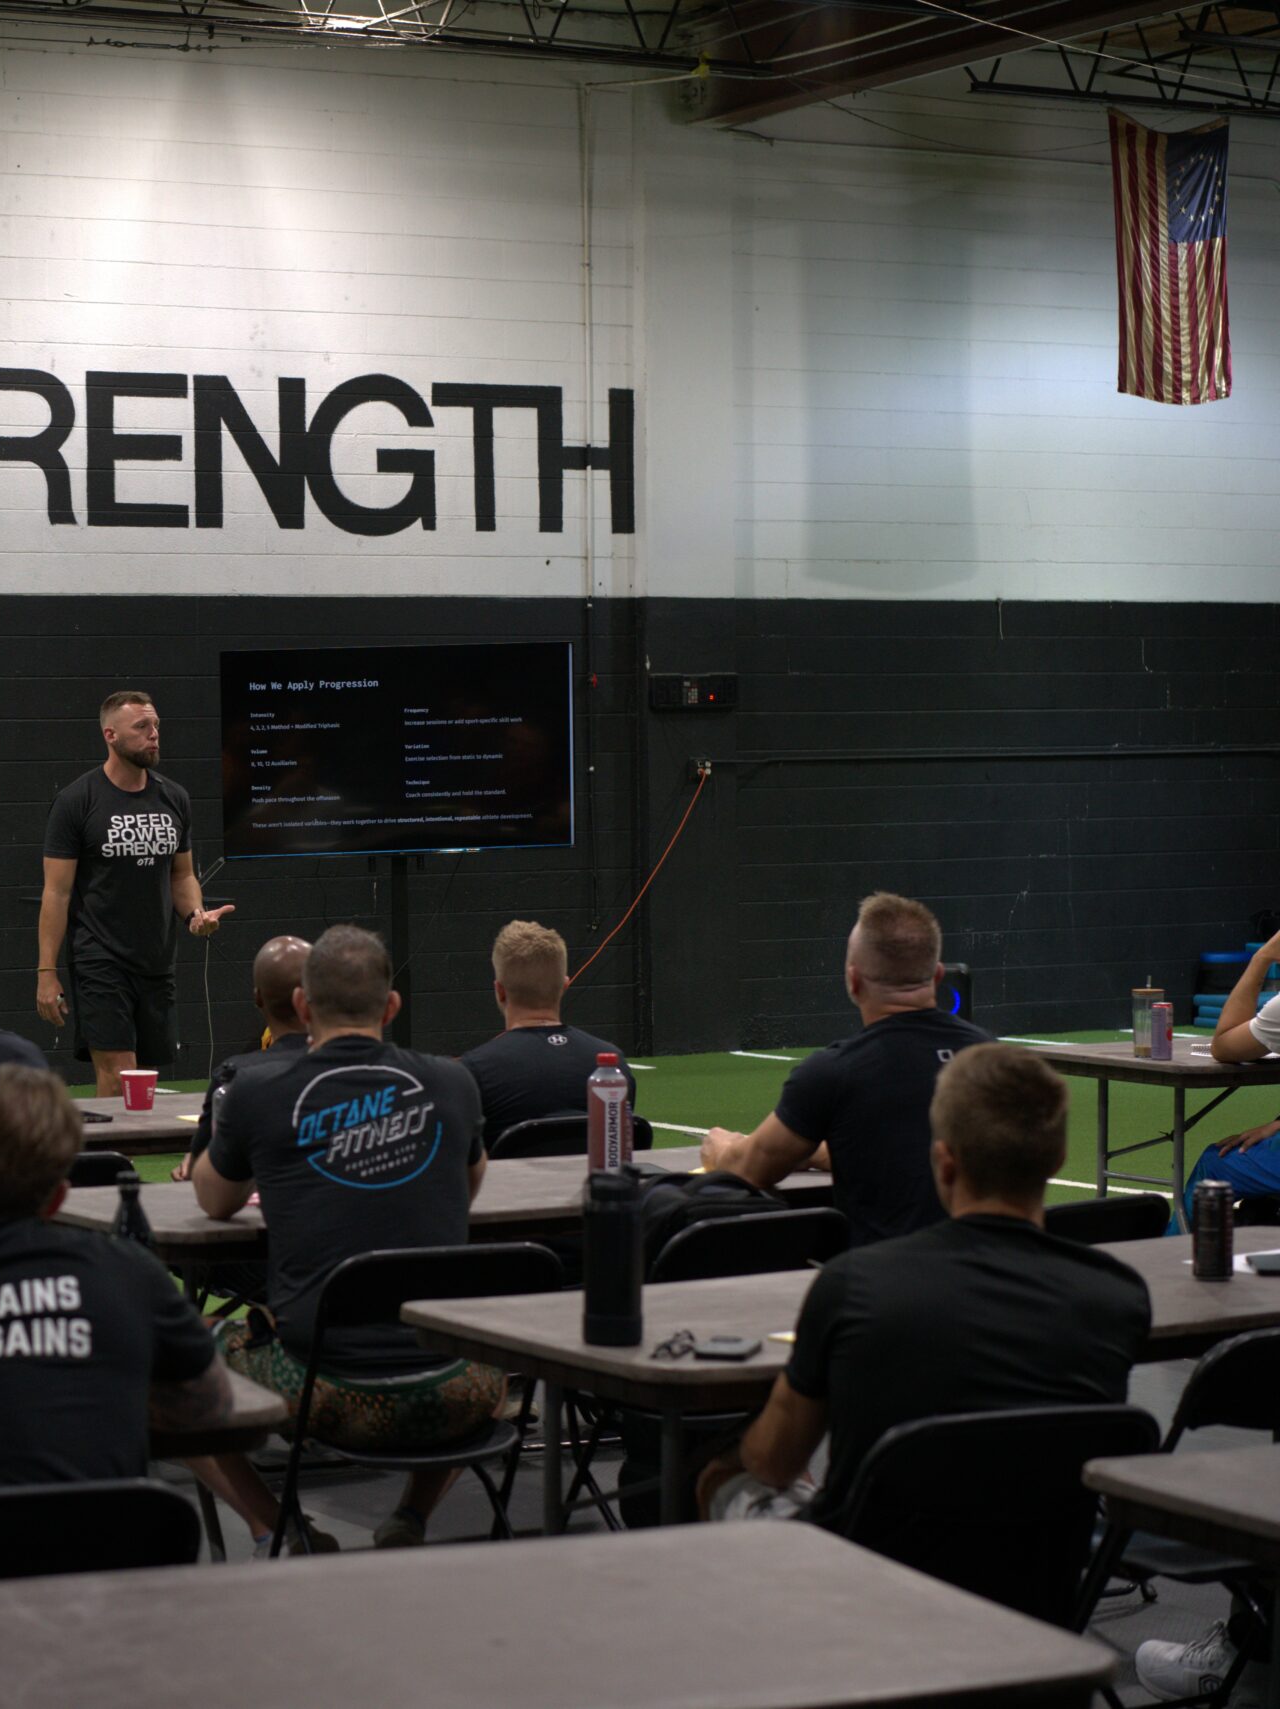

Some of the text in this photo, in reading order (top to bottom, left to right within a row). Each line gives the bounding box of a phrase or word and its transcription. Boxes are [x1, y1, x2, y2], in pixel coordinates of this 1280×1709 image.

[249, 678, 379, 691] How We Apply Progression
[110, 813, 173, 830] SPEED
[107, 827, 177, 844] POWER
[101, 840, 180, 858] STRENGTH
[136, 857, 155, 867] OTA
[296, 1084, 397, 1147] OCTANE
[326, 1101, 435, 1164] FITNESS
[608, 1101, 619, 1168] BODYARMOR
